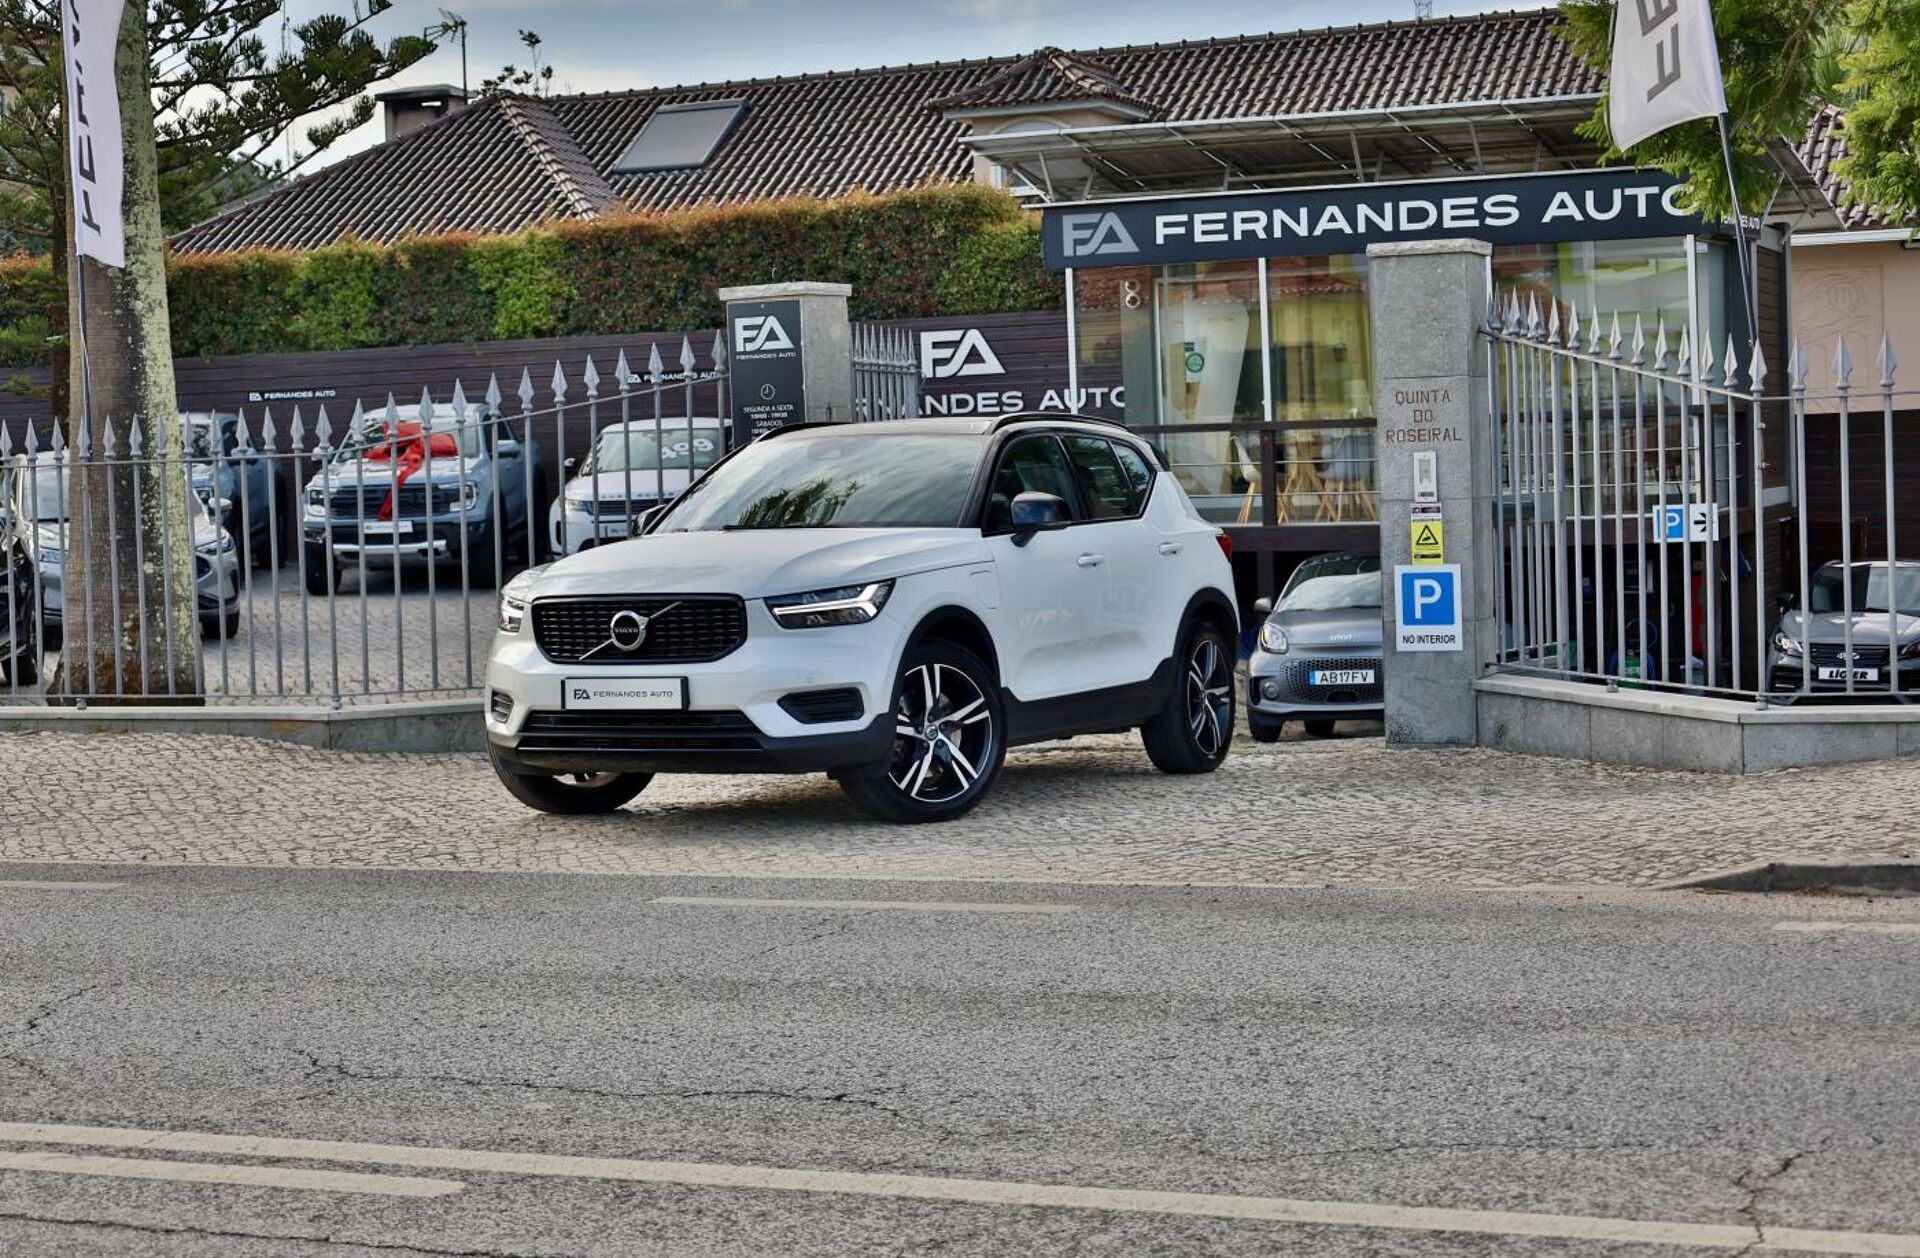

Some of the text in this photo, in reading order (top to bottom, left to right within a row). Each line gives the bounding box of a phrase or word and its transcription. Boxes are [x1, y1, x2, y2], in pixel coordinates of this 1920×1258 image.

[1062, 211, 1140, 257] FA
[1155, 194, 1520, 245] FERNANDES
[735, 316, 795, 352] FA
[920, 329, 1006, 378] FA
[264, 390, 313, 399] FERNANDES
[315, 390, 336, 398] AUTO
[1395, 388, 1451, 406] QUINTA
[1413, 409, 1433, 423] DO
[1386, 426, 1462, 442] ROSEIRAL
[1413, 578, 1442, 620] P
[1403, 634, 1456, 644] NO INTERIOR
[1829, 670, 1868, 680] LIGER
[593, 690, 648, 698] FERNANDES
[650, 690, 673, 698] AUTO
